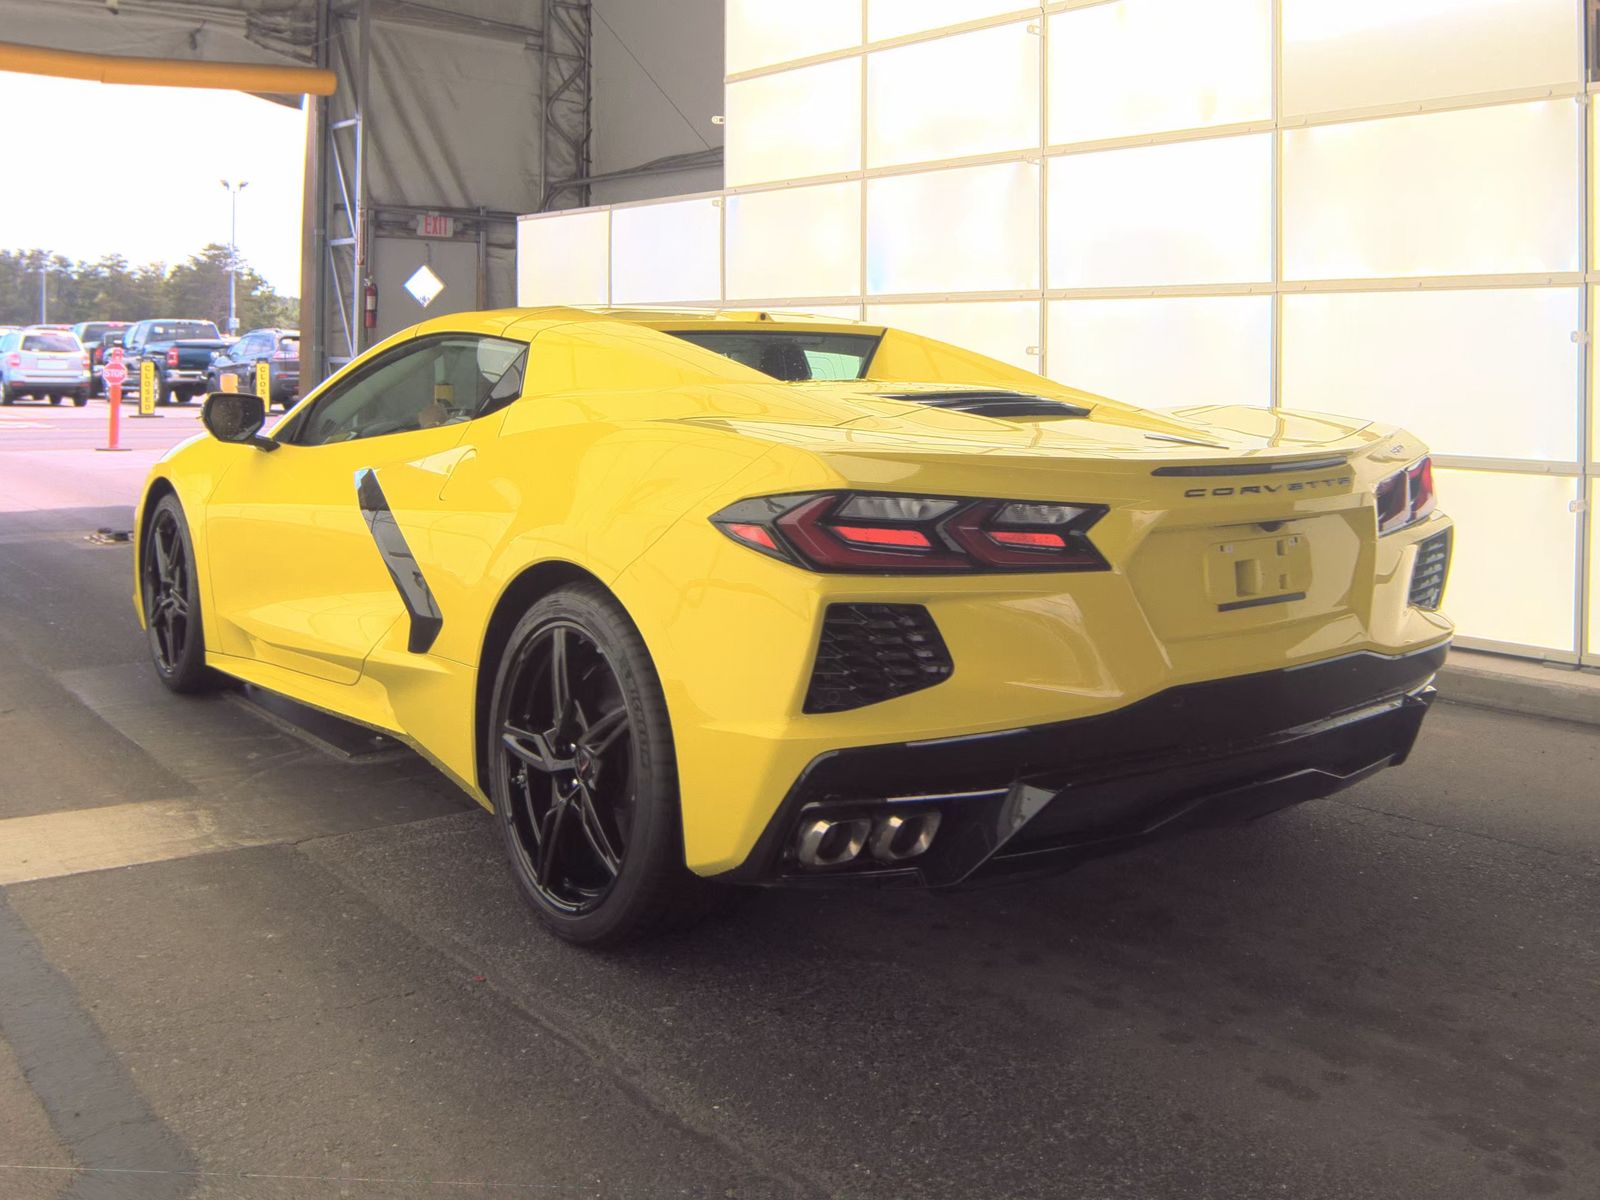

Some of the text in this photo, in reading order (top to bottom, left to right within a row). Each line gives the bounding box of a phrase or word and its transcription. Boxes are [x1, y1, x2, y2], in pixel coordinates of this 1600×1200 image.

[424, 215, 448, 235] EXIT
[103, 369, 125, 378] STOP
[144, 364, 152, 411] CLOSED
[1184, 476, 1351, 498] CORVETTE
